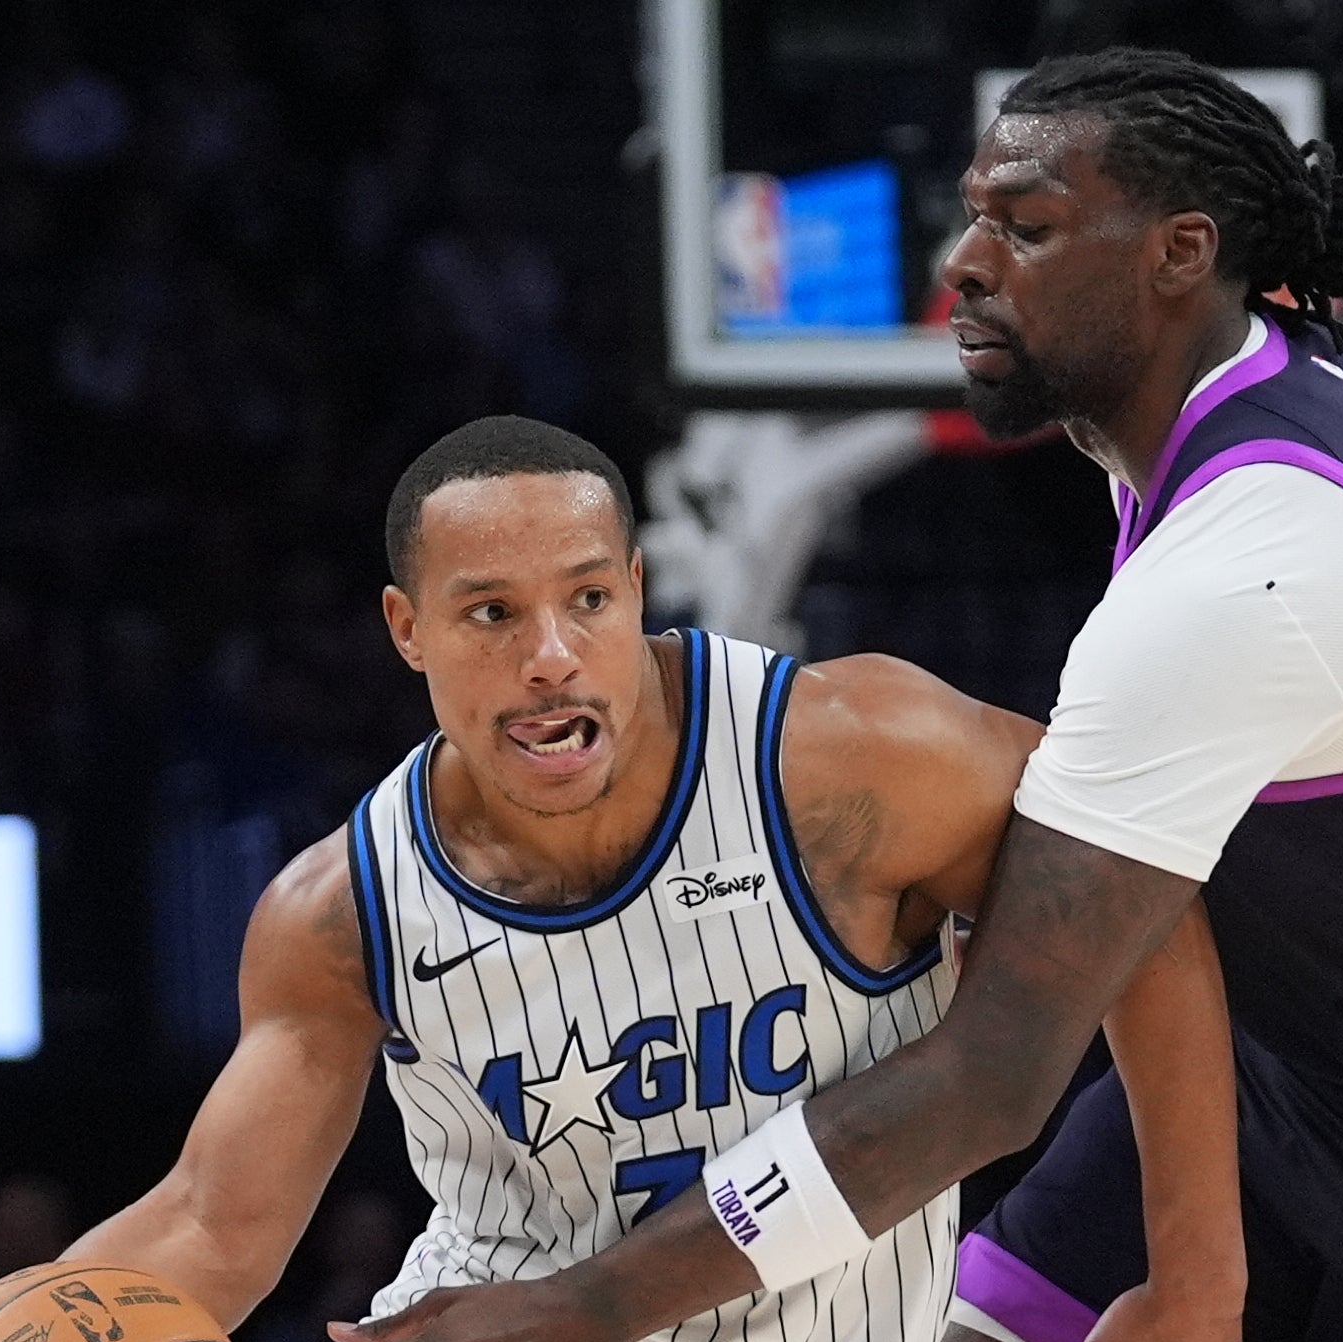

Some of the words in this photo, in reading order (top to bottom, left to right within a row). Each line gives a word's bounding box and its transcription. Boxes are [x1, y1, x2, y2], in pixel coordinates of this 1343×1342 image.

[666, 872, 766, 909] Disney
[711, 1179, 761, 1247] TORAYA
[744, 1161, 790, 1214] 11
